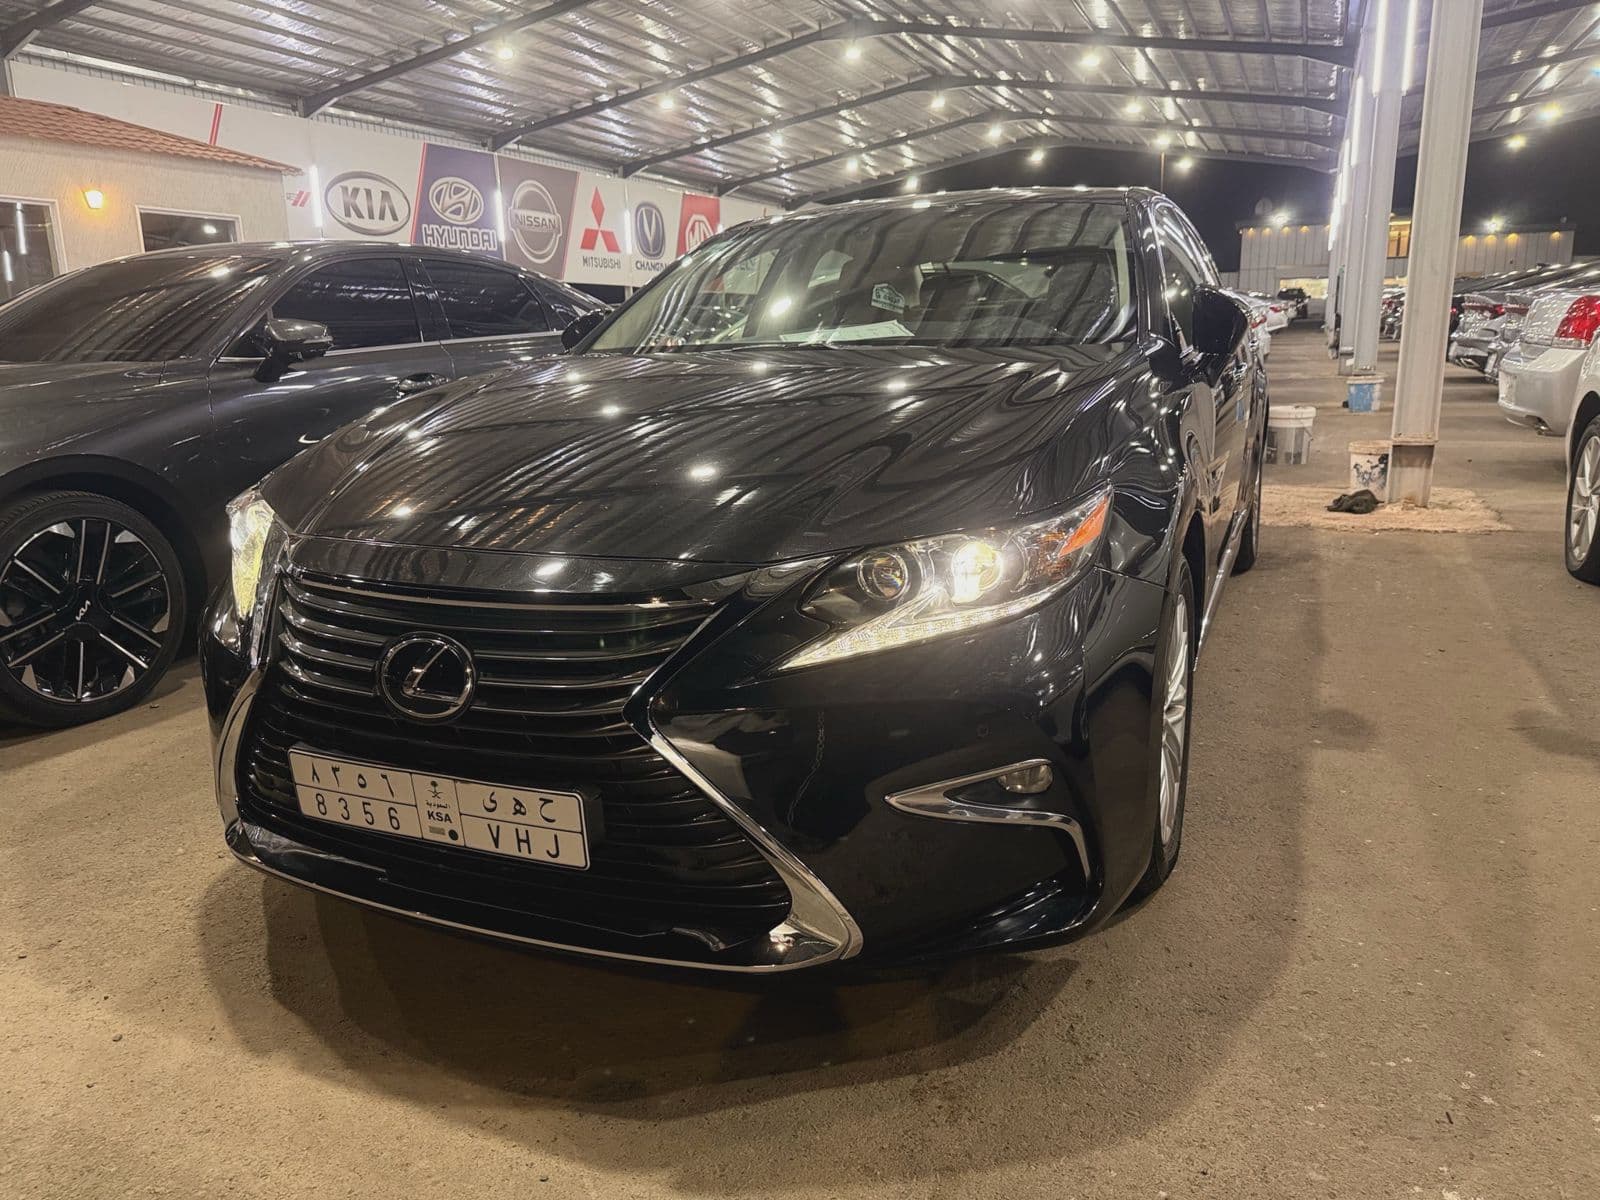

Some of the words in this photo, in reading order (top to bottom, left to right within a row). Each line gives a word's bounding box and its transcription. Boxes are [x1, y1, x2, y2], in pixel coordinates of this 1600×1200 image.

[340, 185, 398, 222] KIA
[514, 213, 556, 229] NISSAN
[422, 224, 497, 250] HYUNDAI
[582, 256, 621, 269] MITSUBISHI
[635, 260, 667, 272] CHANGA
[315, 793, 401, 831] 8356
[427, 810, 453, 824] KSA
[487, 823, 560, 859] VHJ
